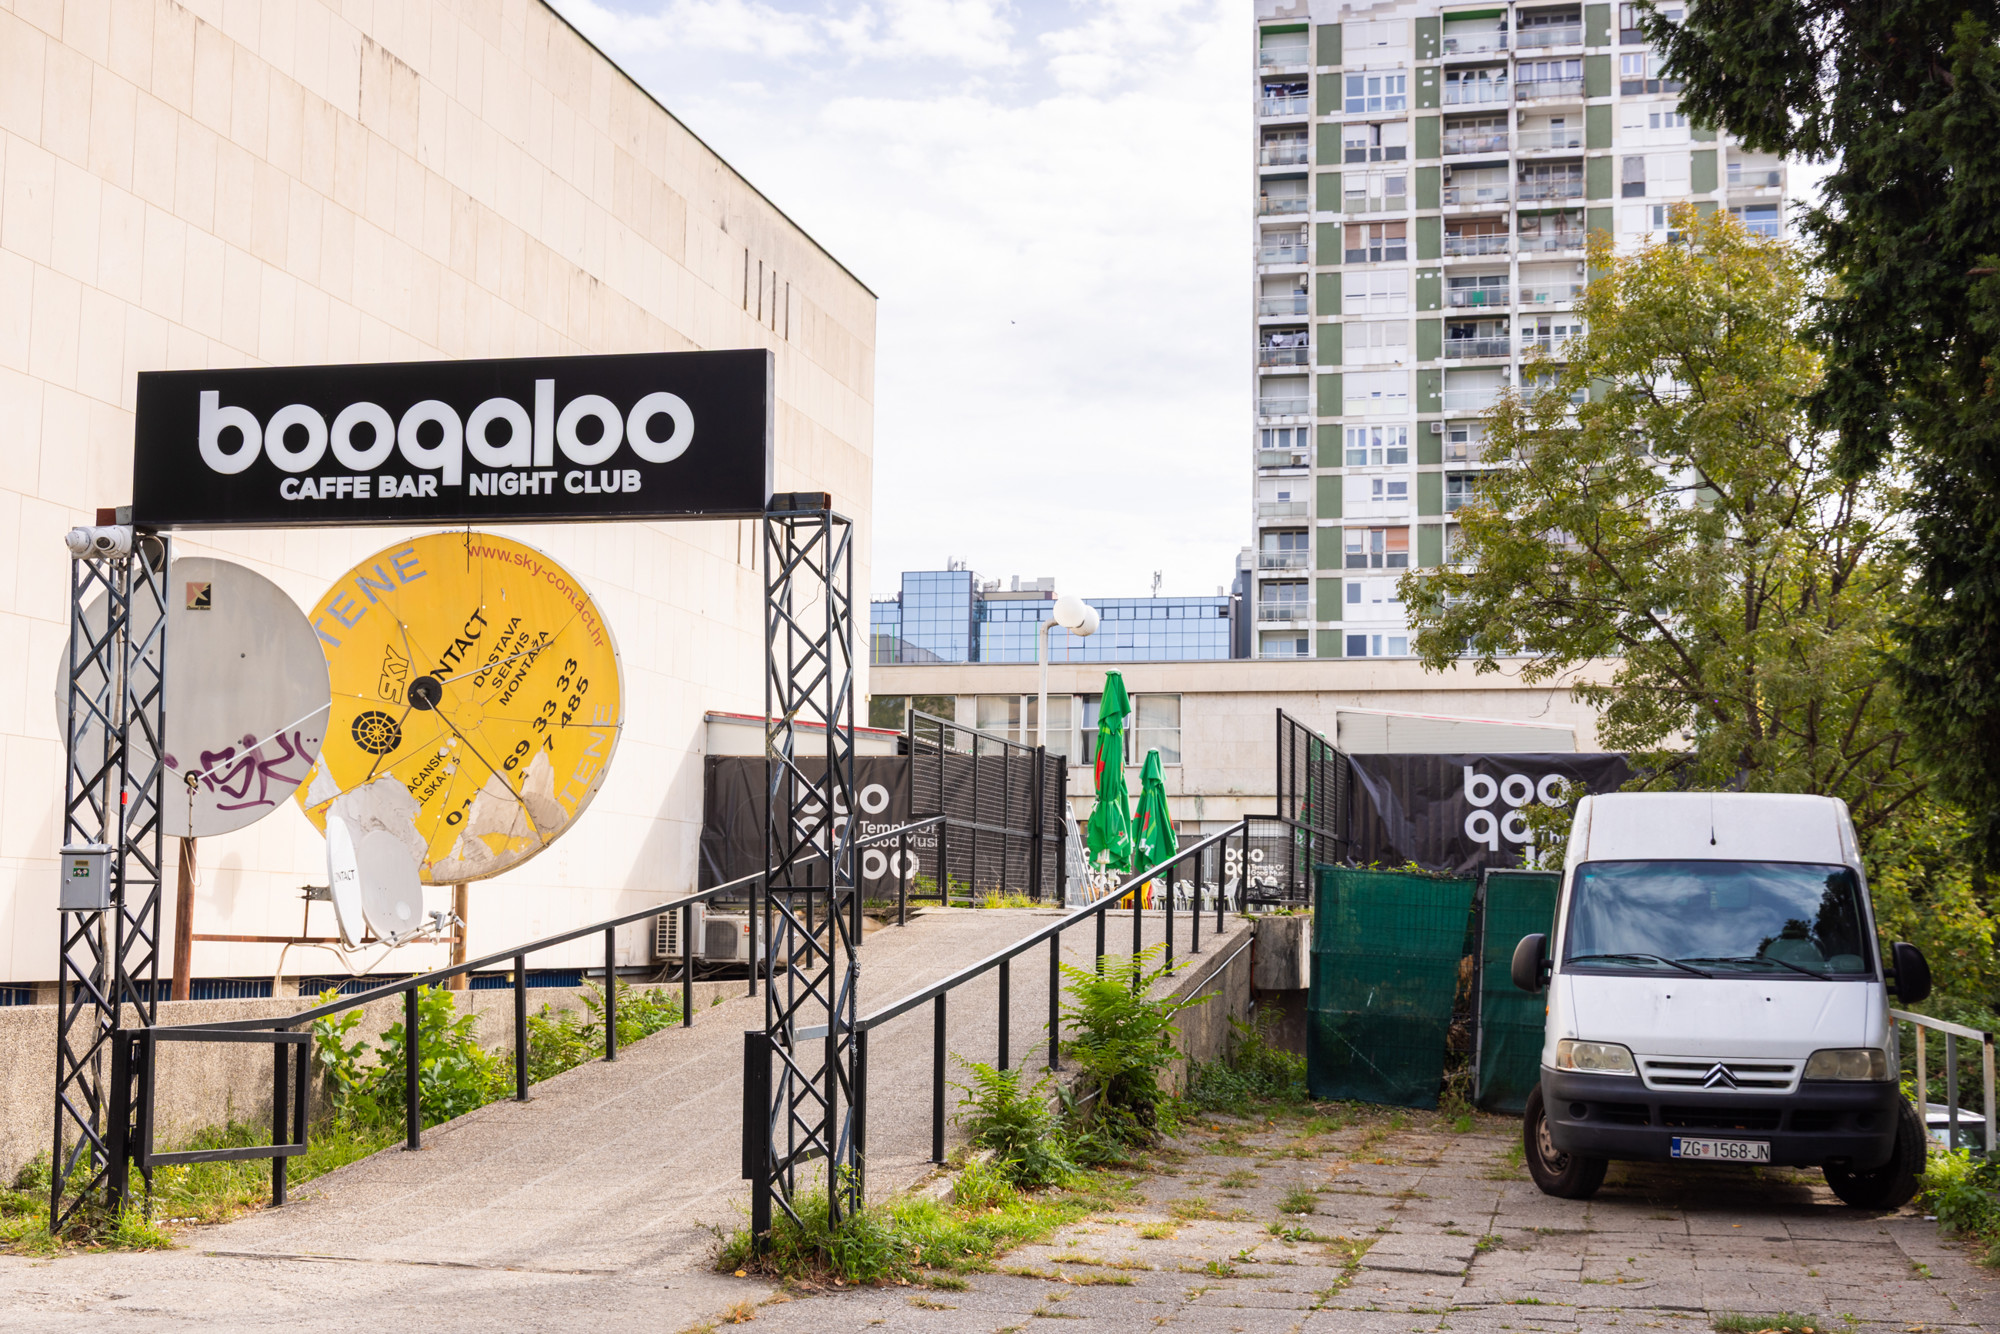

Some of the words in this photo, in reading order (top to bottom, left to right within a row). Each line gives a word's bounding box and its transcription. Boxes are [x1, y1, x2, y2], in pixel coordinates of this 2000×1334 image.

[280, 476, 371, 501] CAFFE
[378, 475, 438, 499] BAR
[469, 471, 558, 497] NIGHT
[564, 469, 642, 494] CLUB
[313, 547, 427, 660] TENE
[465, 545, 604, 647] www.sky-contact.hr
[378, 644, 409, 704] SKY
[430, 607, 487, 682] NTACT
[473, 617, 521, 688] DOSTAVA
[491, 632, 529, 689] SERVIS
[499, 631, 549, 706] MONTAŽA
[503, 740, 531, 771] 69
[533, 700, 557, 734] 33
[557, 658, 577, 692] 33
[561, 676, 588, 729] 485
[1683, 1141, 1700, 1156] ZG
